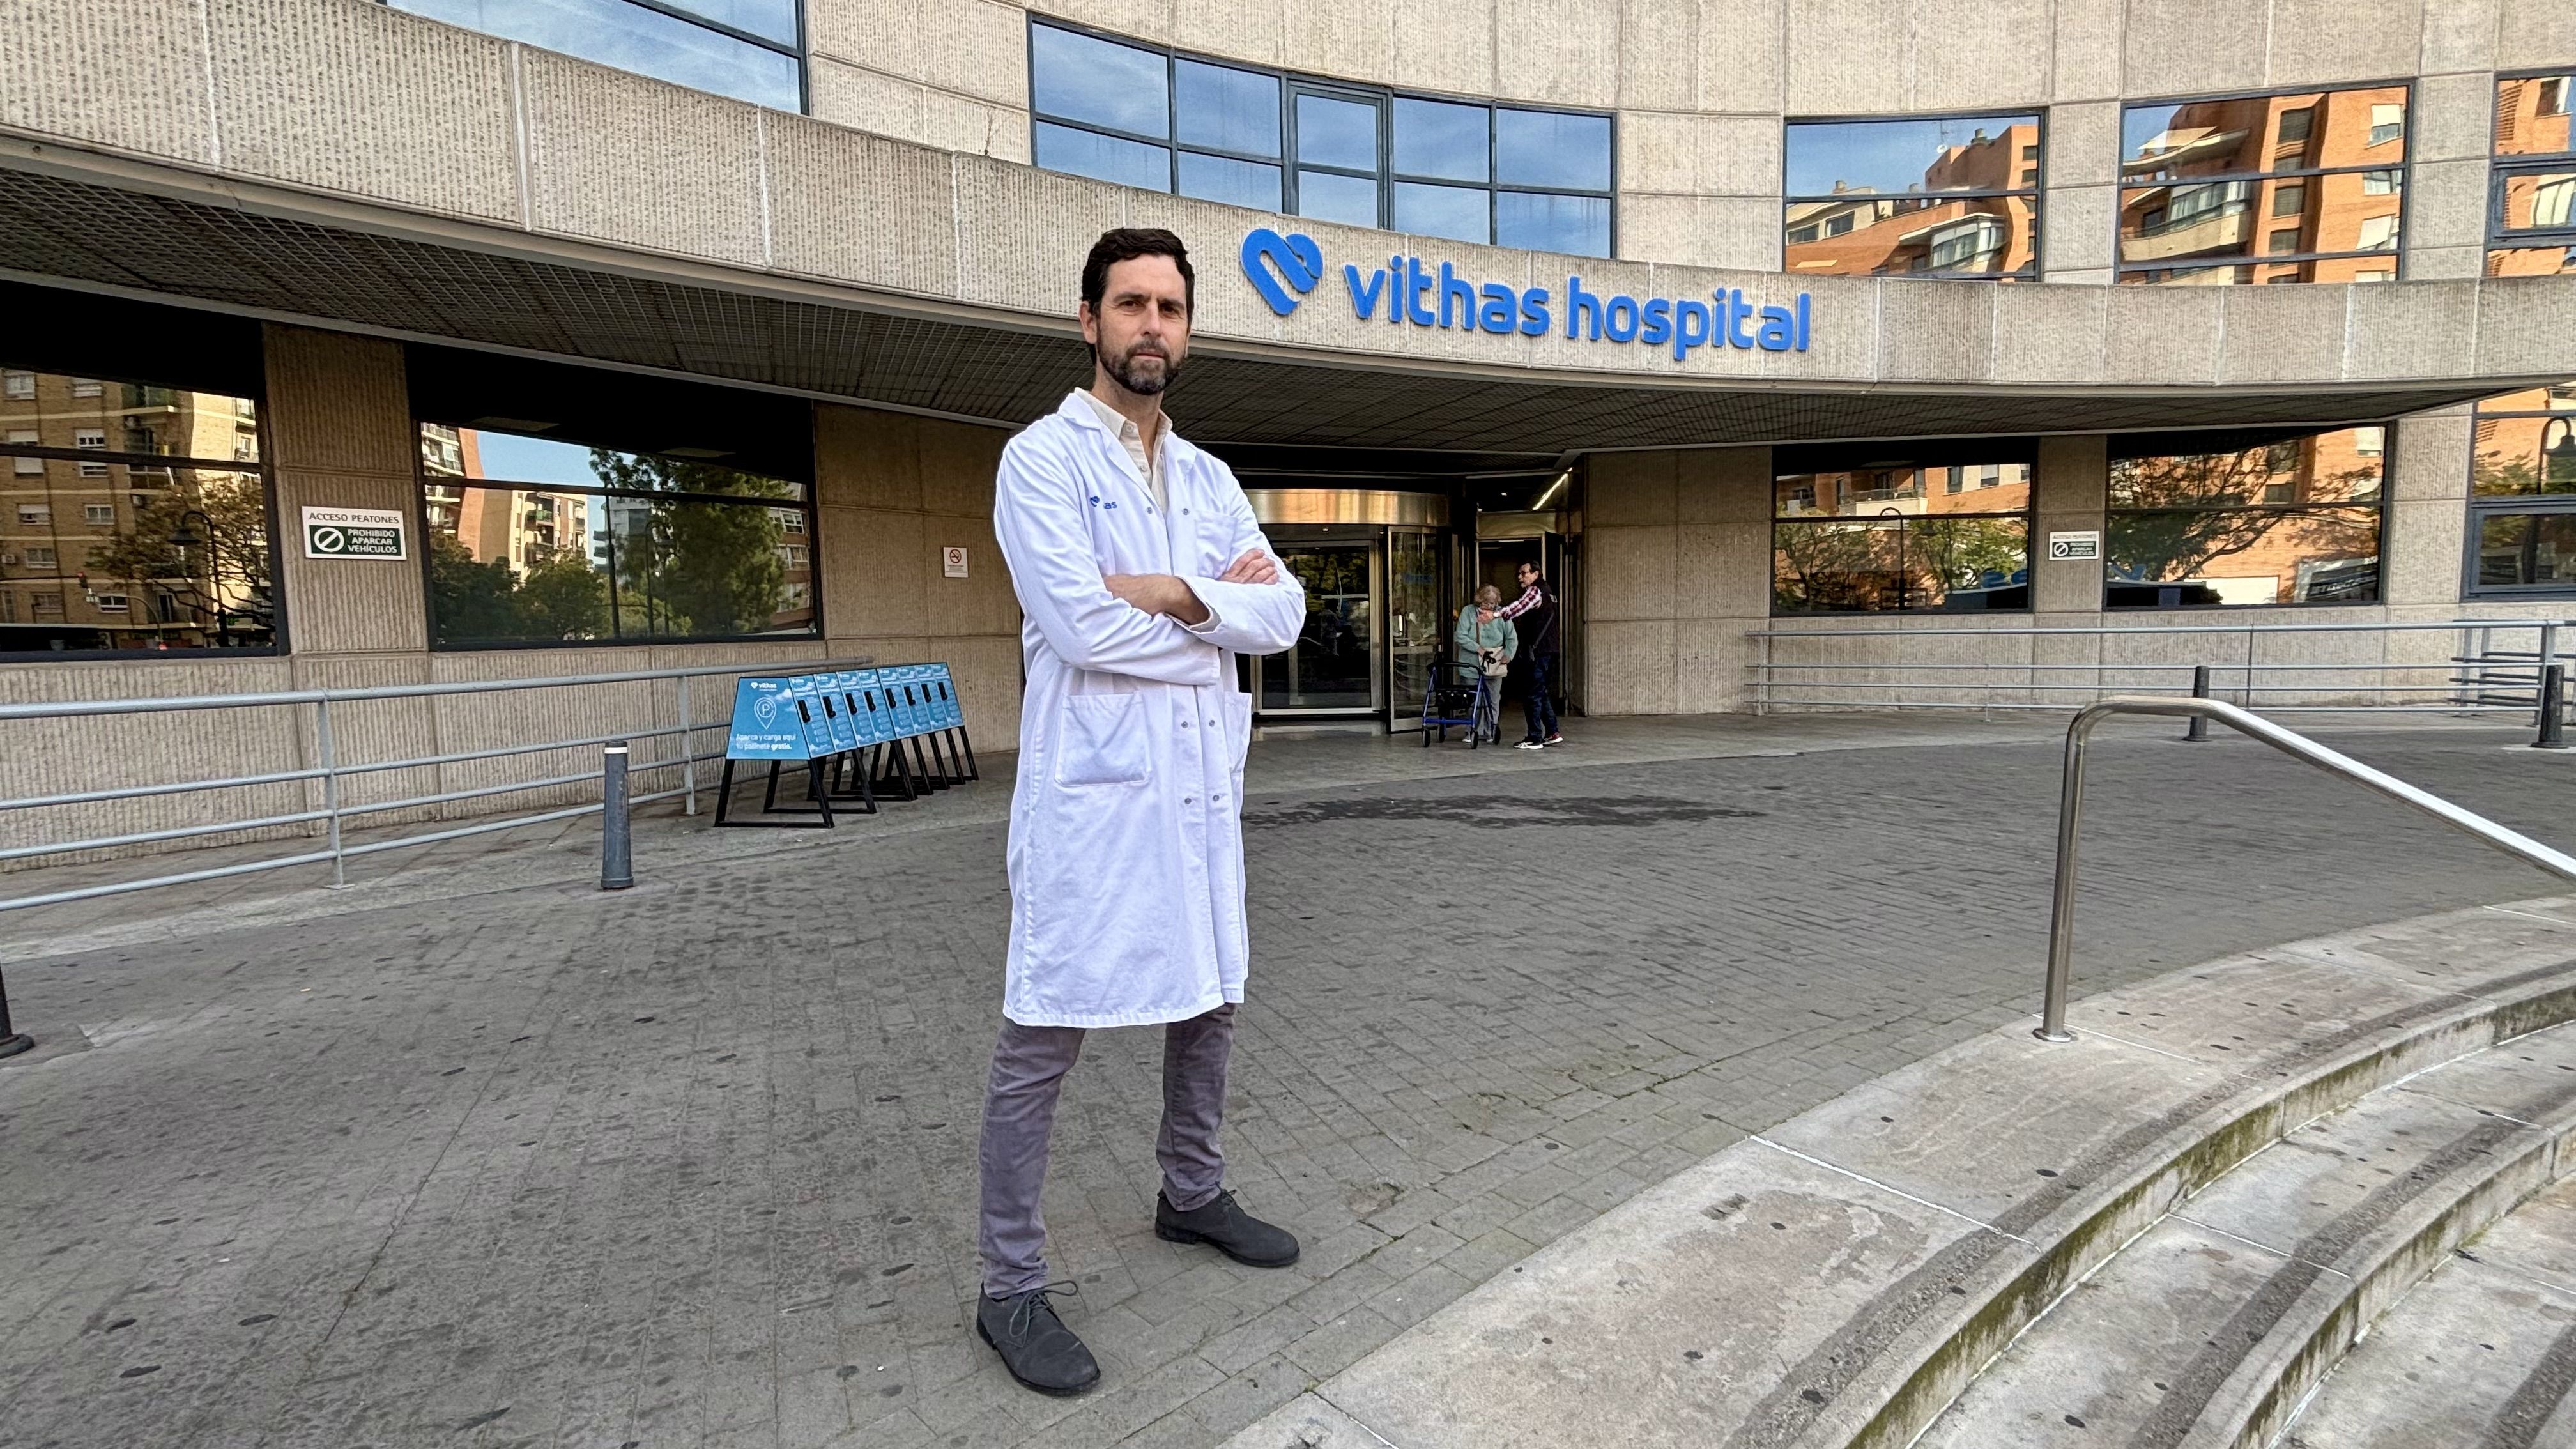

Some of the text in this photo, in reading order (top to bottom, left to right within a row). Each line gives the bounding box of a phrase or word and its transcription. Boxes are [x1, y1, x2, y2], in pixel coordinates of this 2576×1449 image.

[1343, 255, 1811, 361] vithas hospital
[309, 512, 399, 524] ACCESO PEATONES
[348, 528, 395, 538] PROHIBIDO
[348, 544, 397, 553] VEHÍCULOS
